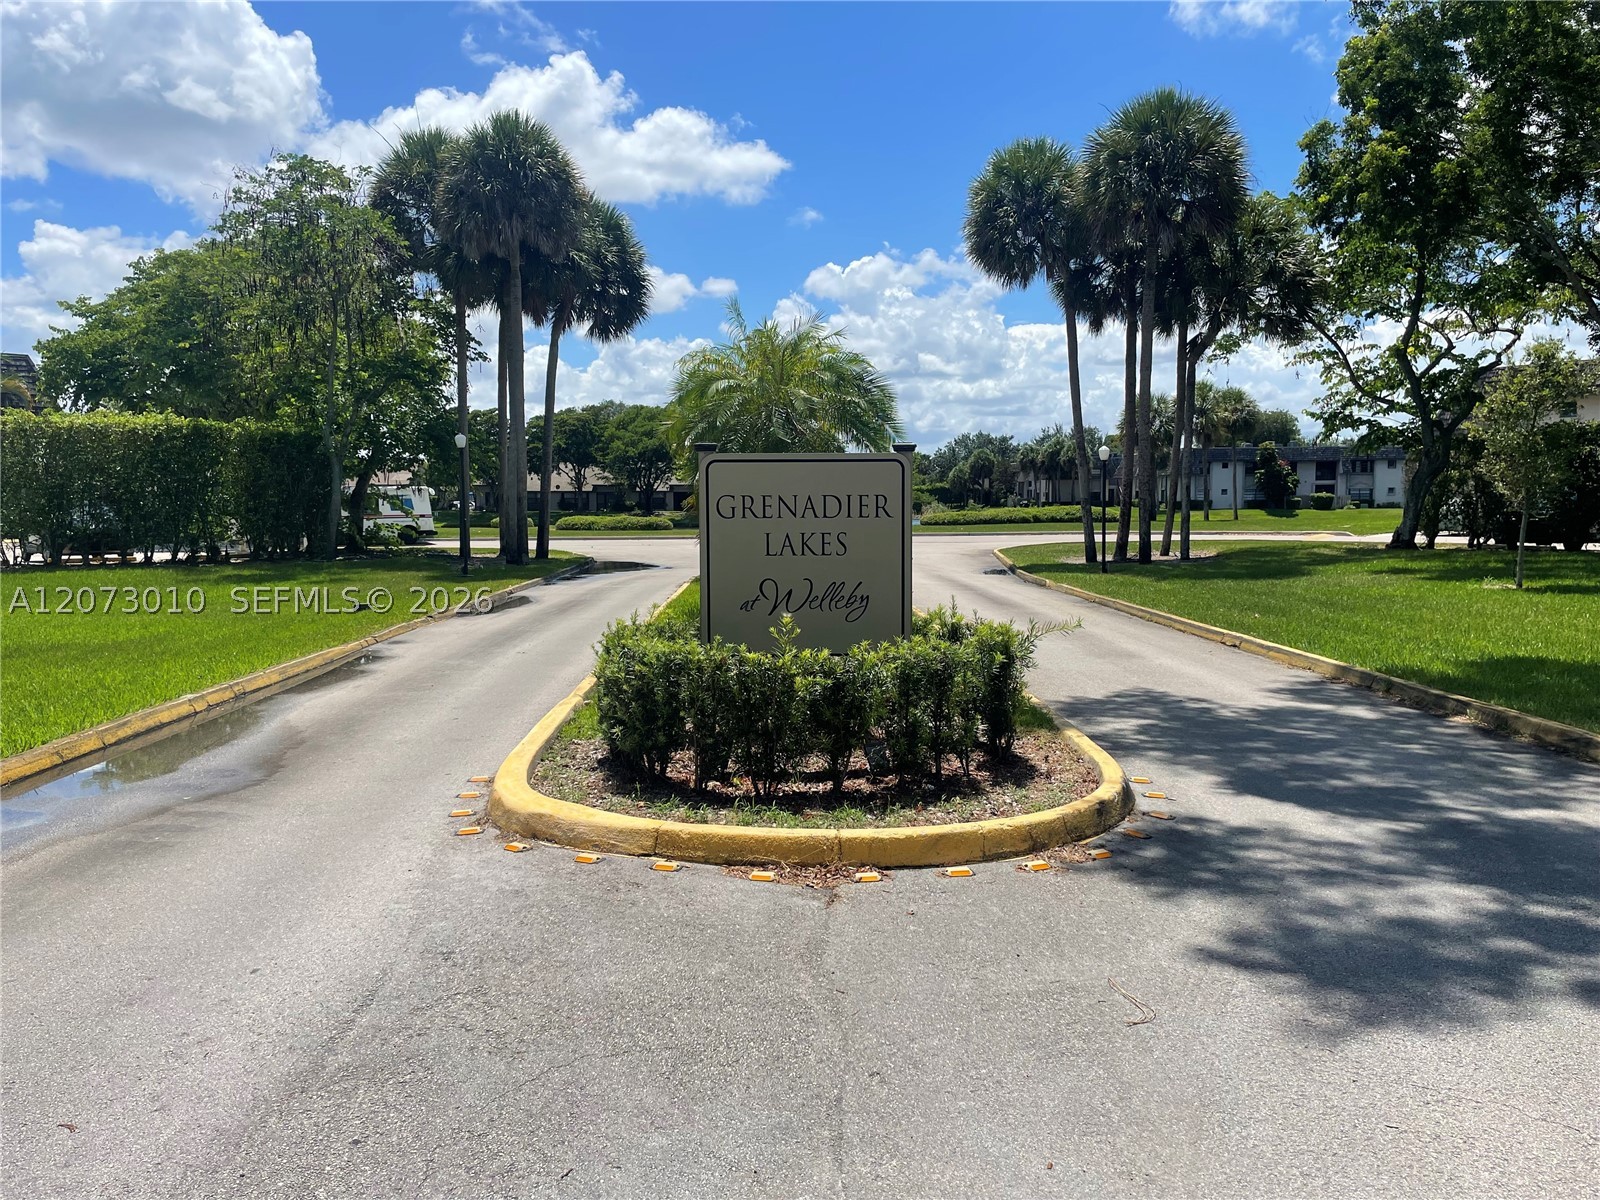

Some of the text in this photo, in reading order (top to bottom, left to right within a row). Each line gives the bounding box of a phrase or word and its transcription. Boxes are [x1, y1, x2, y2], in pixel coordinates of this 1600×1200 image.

[715, 494, 894, 520] GRENADIER
[764, 531, 848, 557] LAKES
[739, 577, 870, 623] at Welleby
